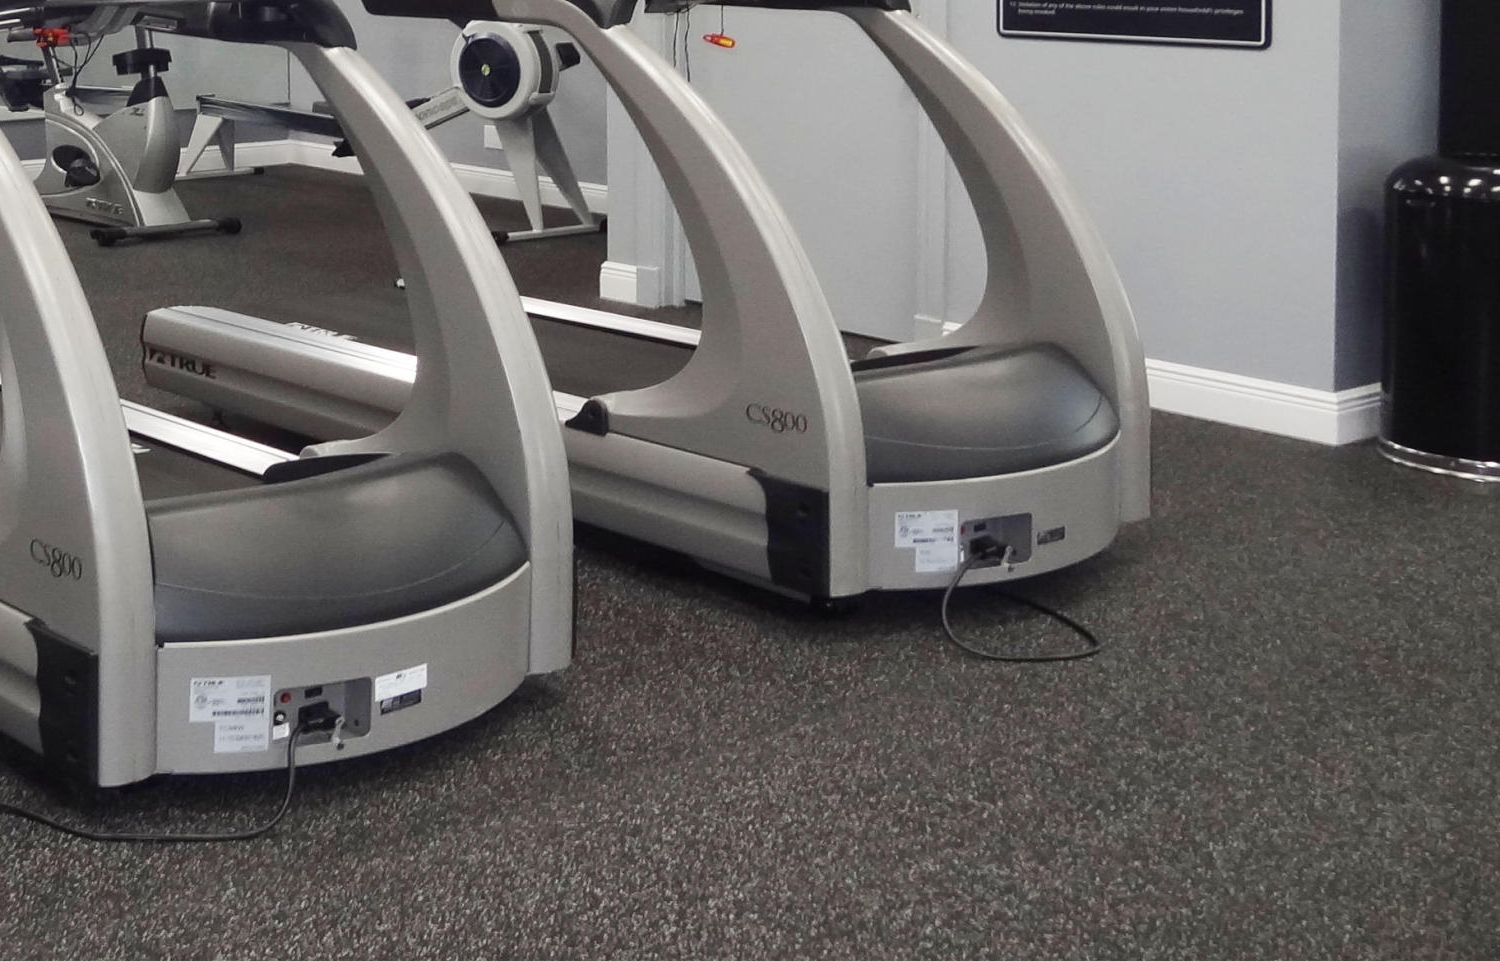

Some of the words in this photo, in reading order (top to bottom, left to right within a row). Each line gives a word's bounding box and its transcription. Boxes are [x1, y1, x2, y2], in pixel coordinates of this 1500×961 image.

[168, 353, 216, 379] TRUE
[746, 403, 808, 433] CS800
[29, 538, 82, 580] CS800
